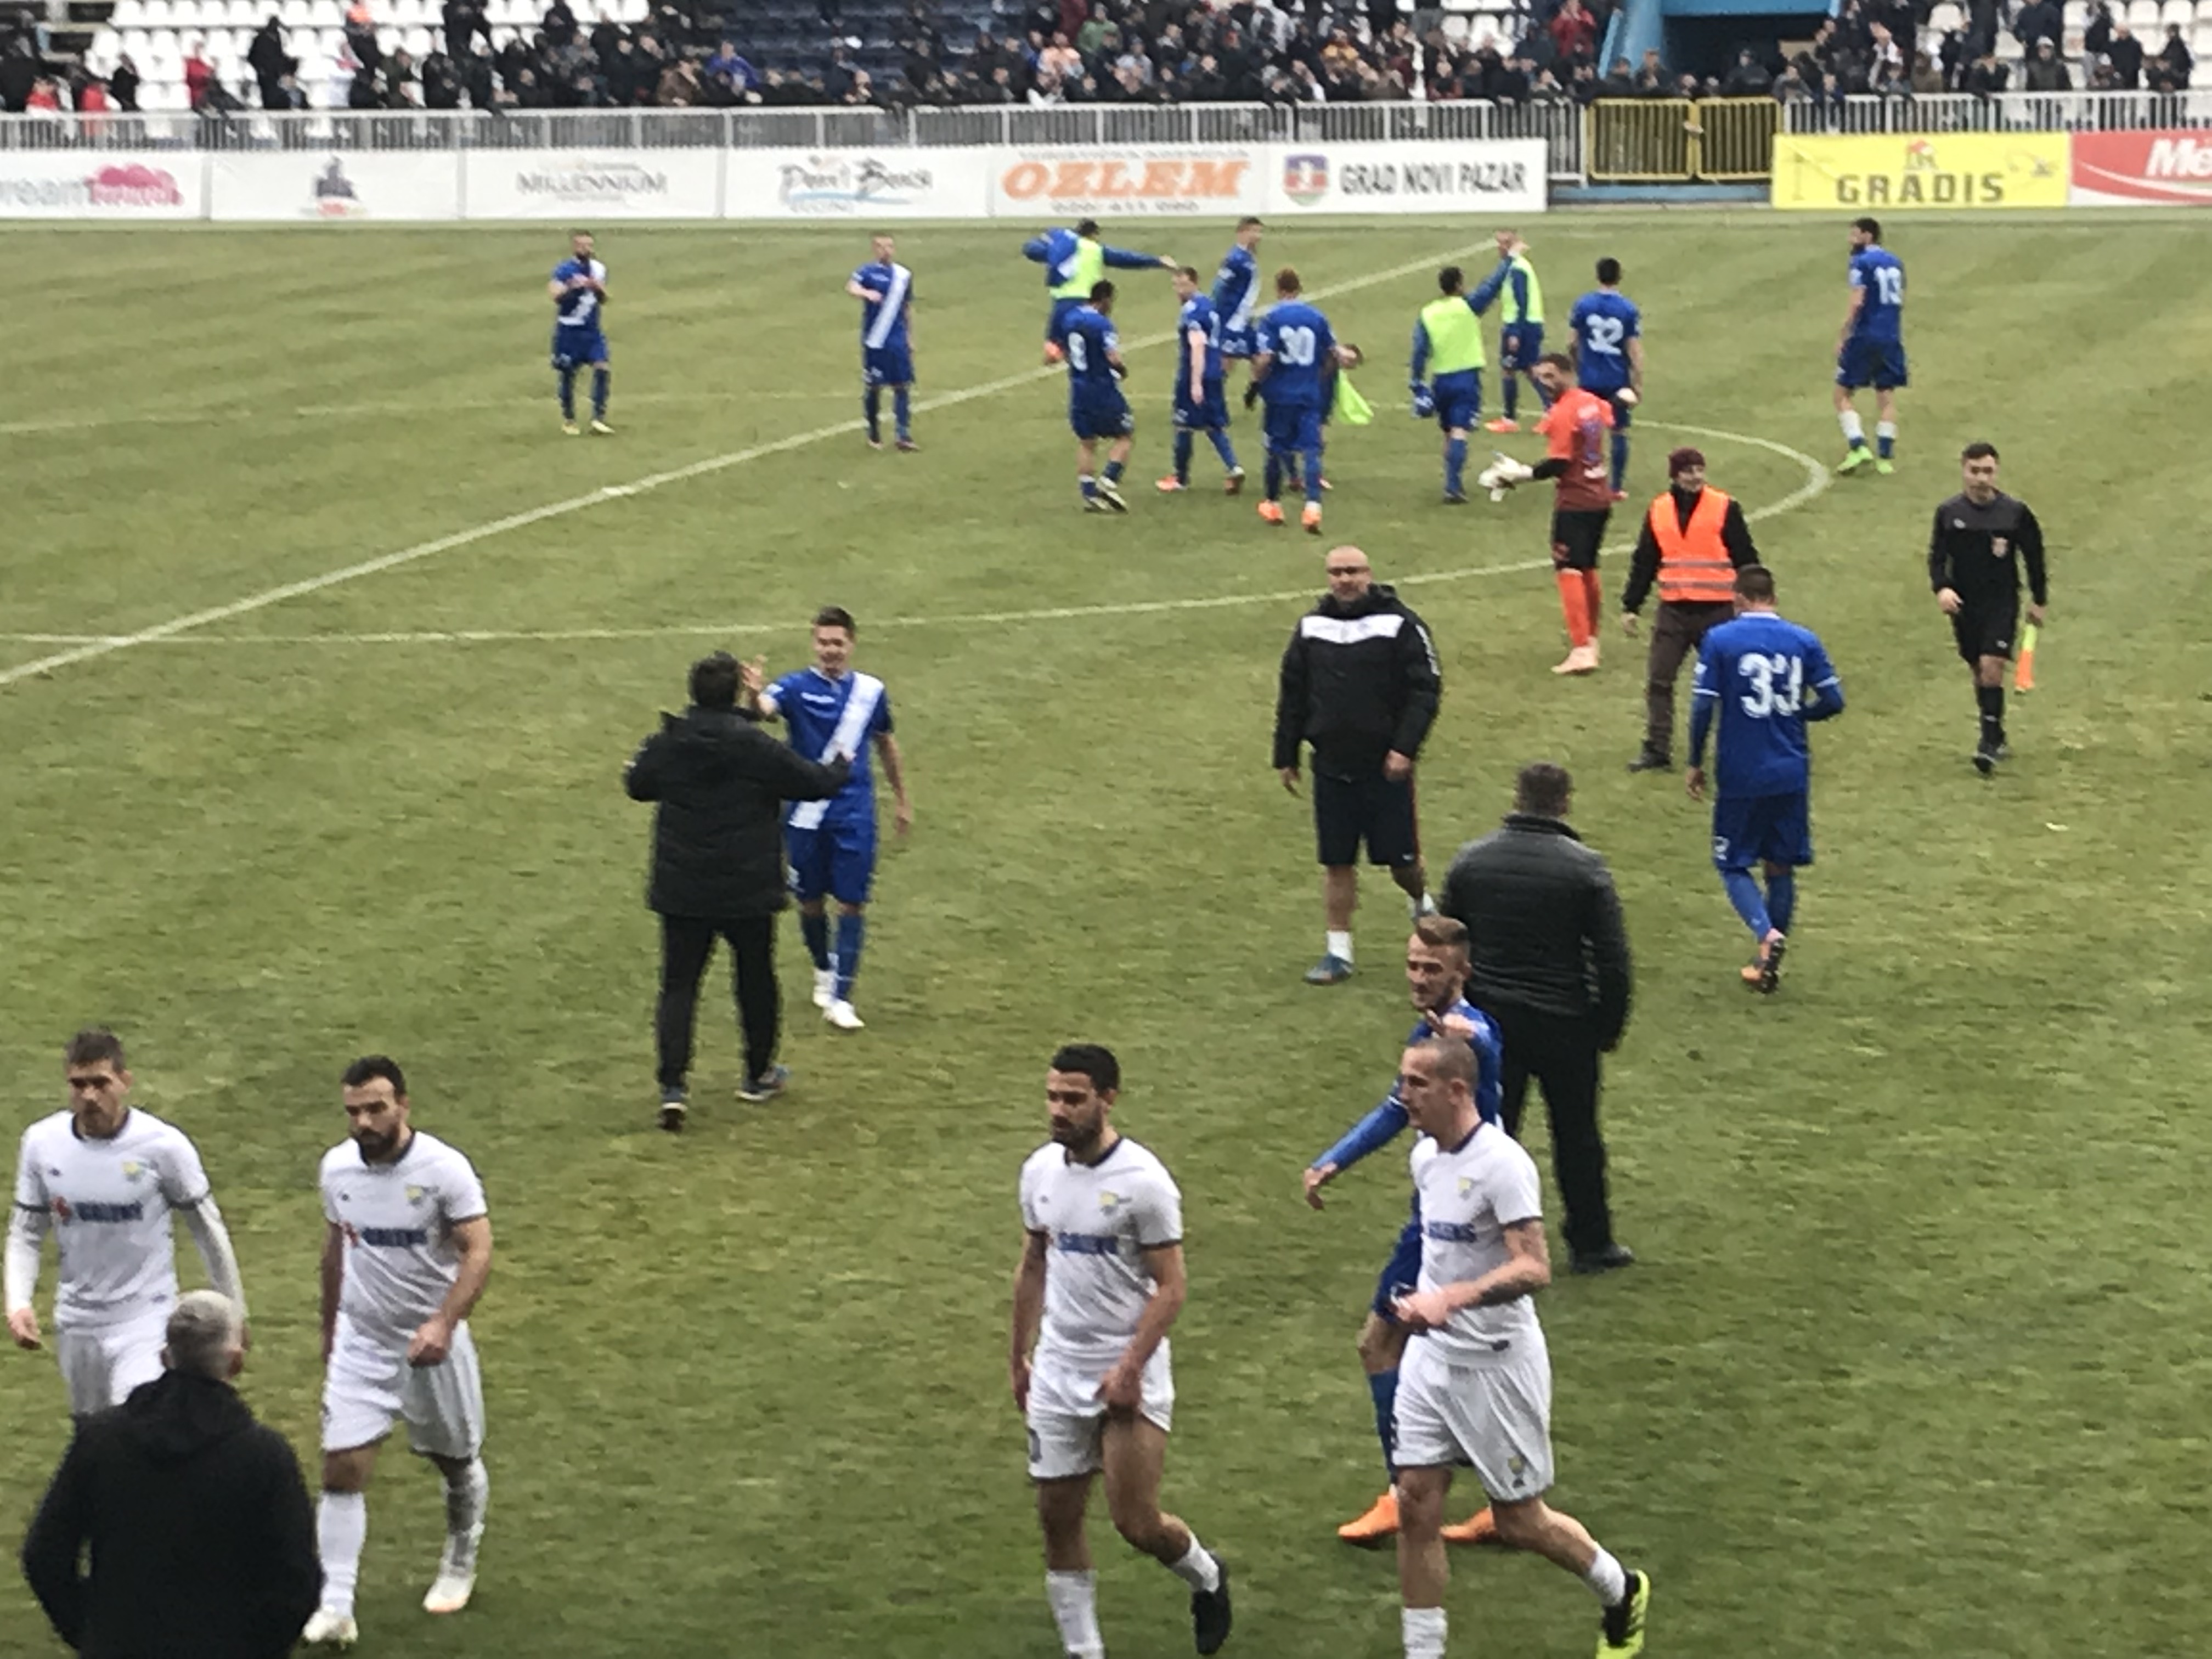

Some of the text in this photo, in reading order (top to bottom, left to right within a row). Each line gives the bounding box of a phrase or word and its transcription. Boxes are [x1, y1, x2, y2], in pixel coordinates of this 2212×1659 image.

[517, 171, 667, 194] MILLENNIUM
[1001, 159, 1251, 200] OZLEM
[1339, 161, 1527, 195] GRAD NOVI PAZAR
[1835, 172, 2005, 205] GRADIS
[1278, 325, 1317, 366] 30
[1586, 313, 1624, 356] 32
